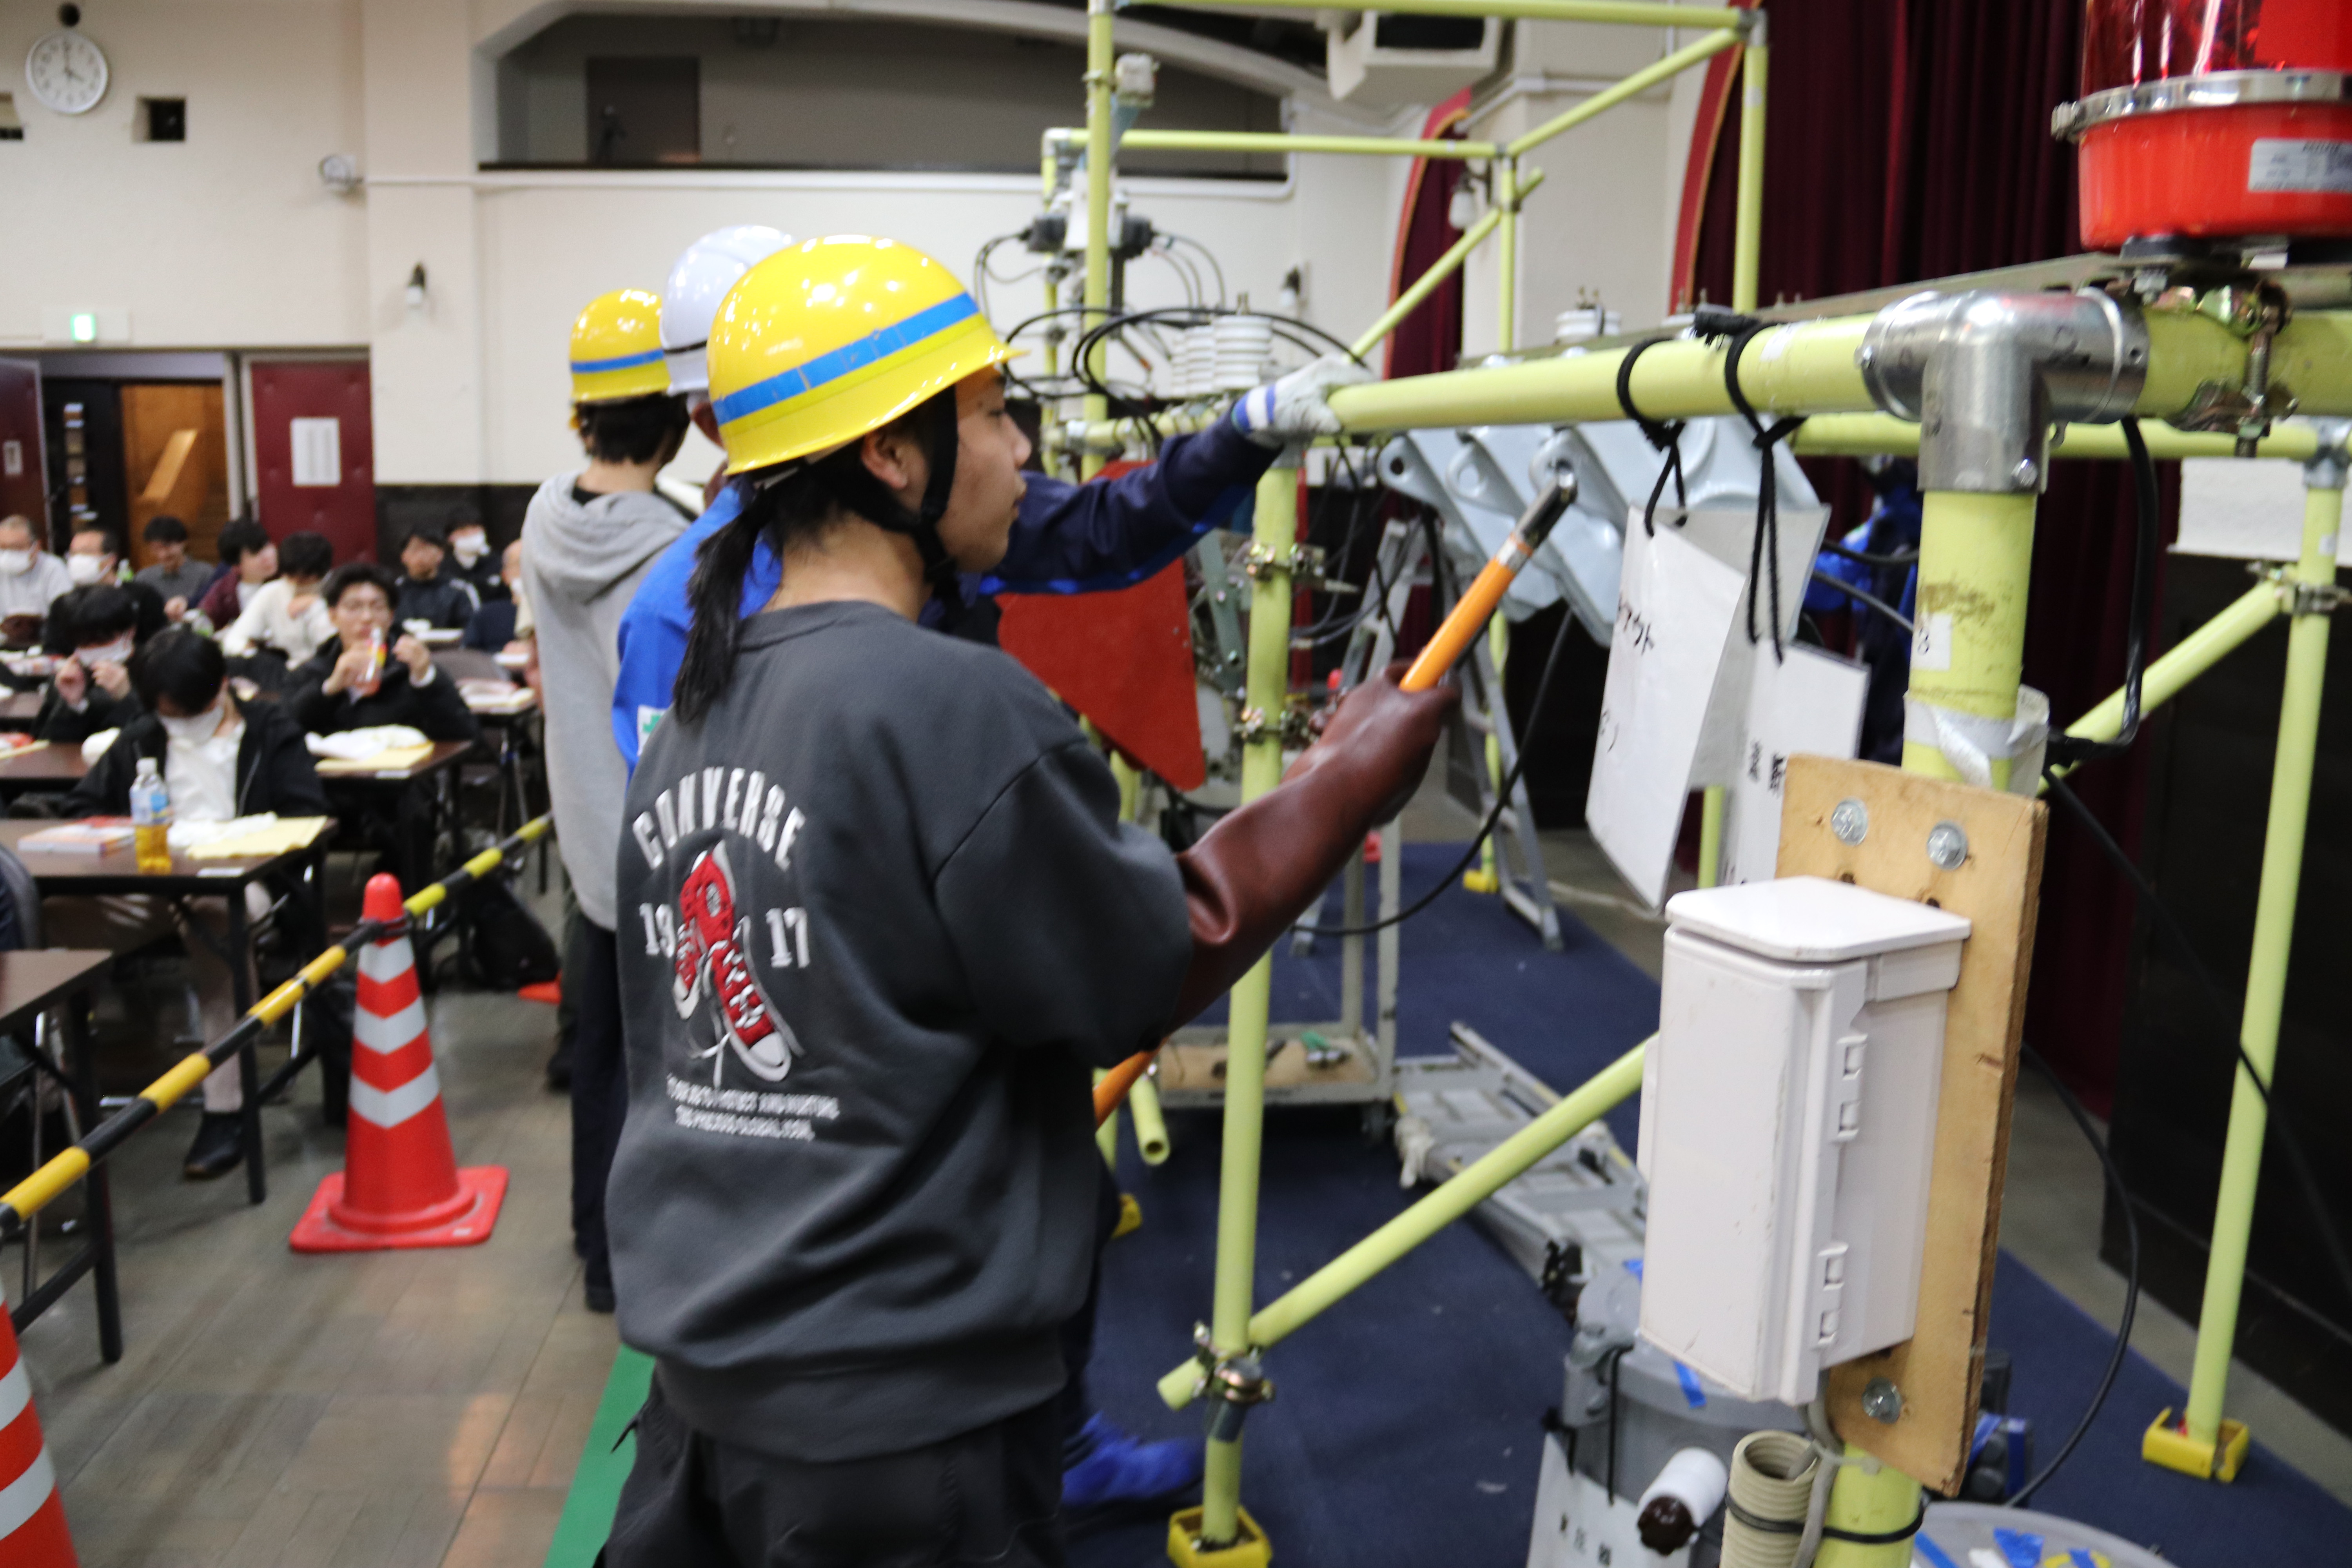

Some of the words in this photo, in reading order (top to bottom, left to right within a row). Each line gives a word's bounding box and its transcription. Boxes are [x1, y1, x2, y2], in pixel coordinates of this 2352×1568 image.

[632, 766, 806, 872] CONVERSE
[639, 902, 676, 959] 19
[765, 907, 810, 969] 17
